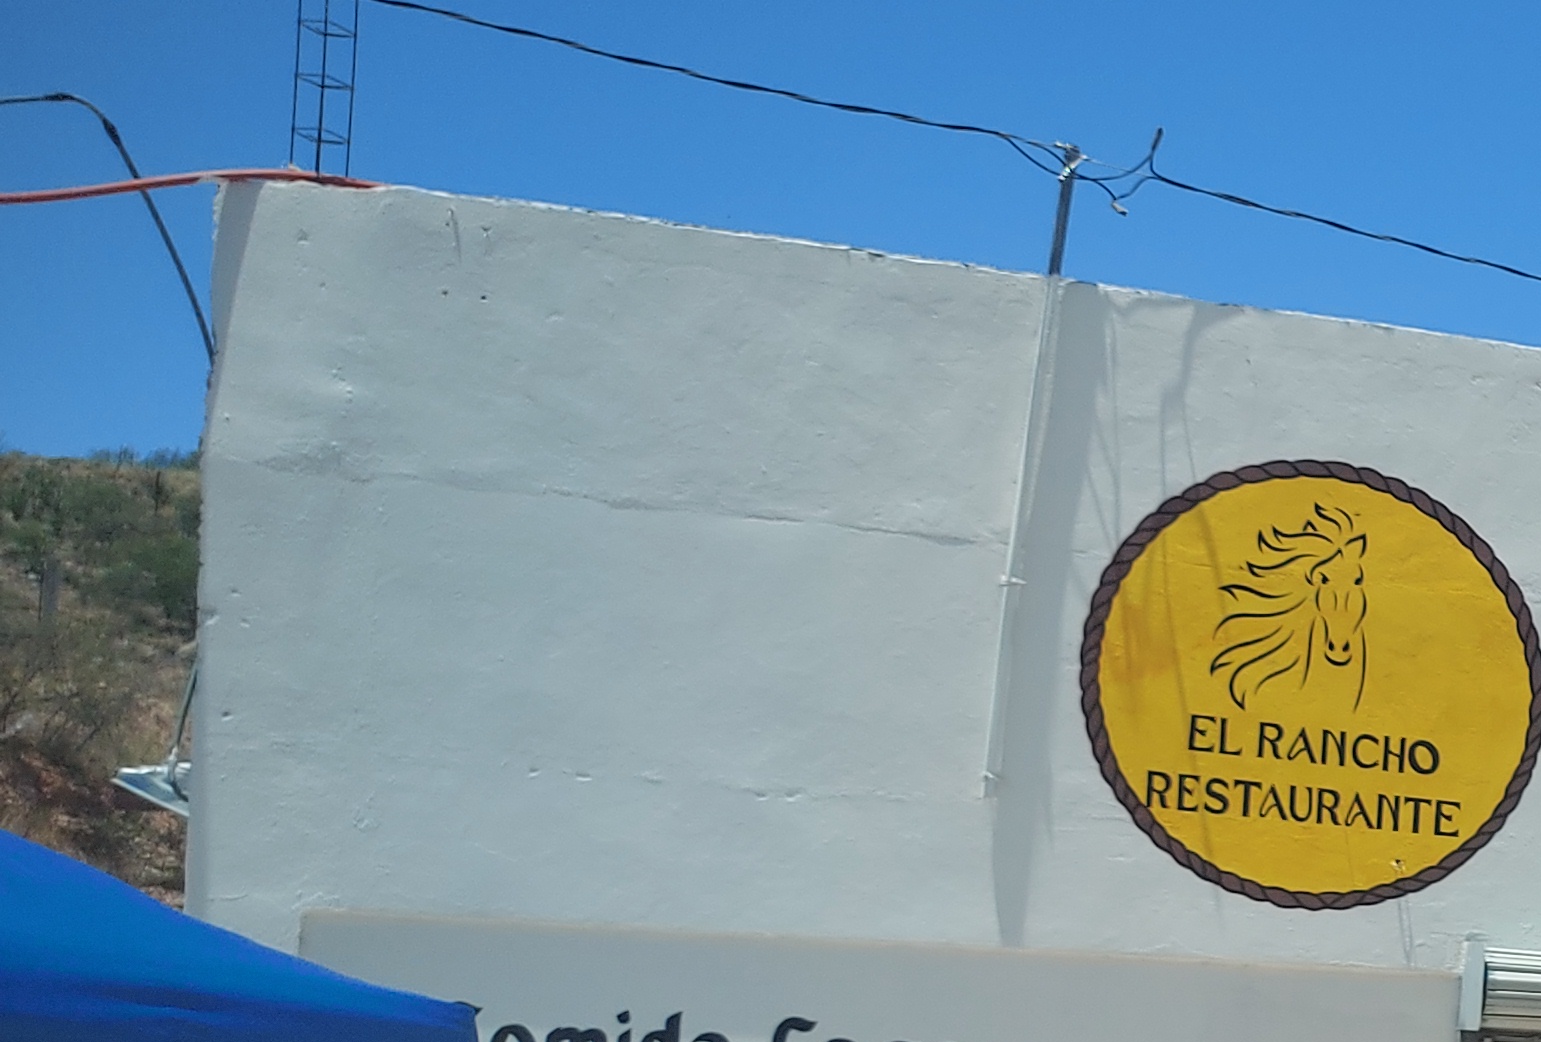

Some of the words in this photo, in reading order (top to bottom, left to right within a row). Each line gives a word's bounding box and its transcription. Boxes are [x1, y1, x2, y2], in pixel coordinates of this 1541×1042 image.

[1187, 714, 1242, 757] EL
[1257, 721, 1440, 776] RANCHO
[1145, 770, 1462, 838] RESTAURANTE
